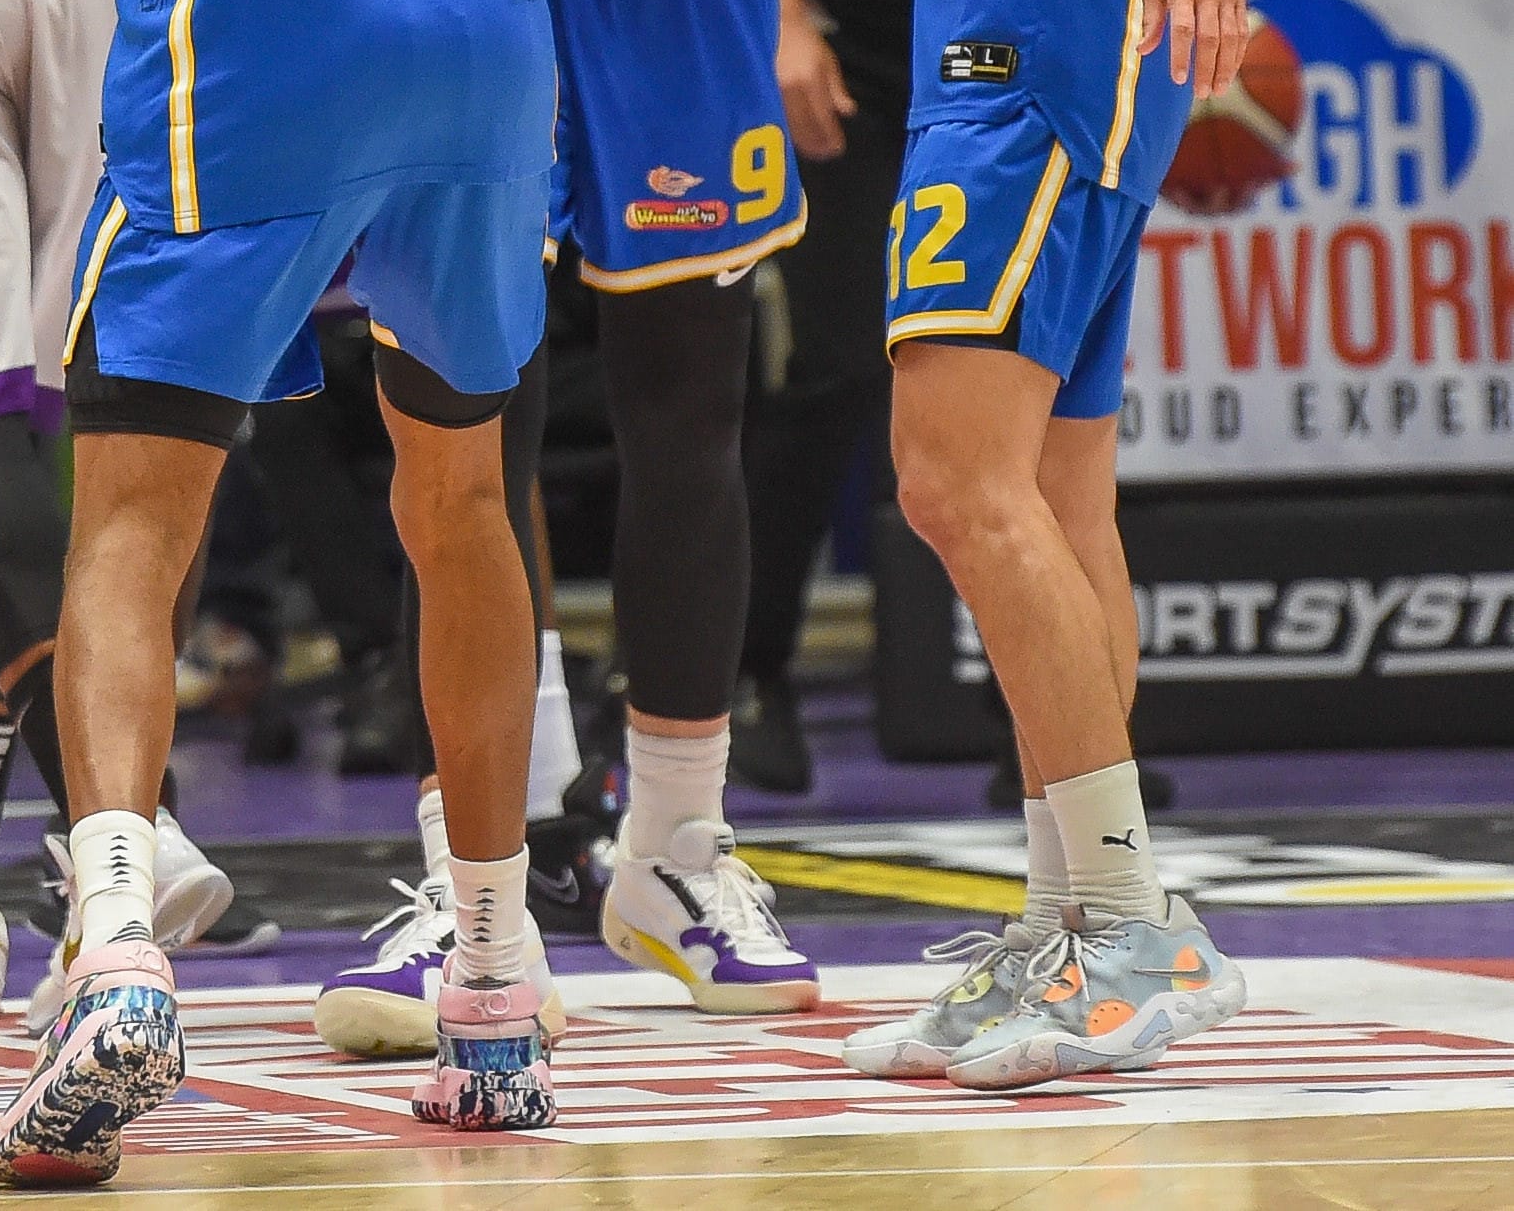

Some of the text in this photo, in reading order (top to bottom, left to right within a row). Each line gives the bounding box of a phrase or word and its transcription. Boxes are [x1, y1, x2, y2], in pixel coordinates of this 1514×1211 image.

[984, 48, 994, 64] L
[732, 123, 786, 225] 9
[1297, 61, 1444, 213] GH
[636, 208, 699, 224] Winner
[890, 182, 967, 302] 12
[1126, 220, 1514, 374] TWOR
[1118, 386, 1242, 445] OUD
